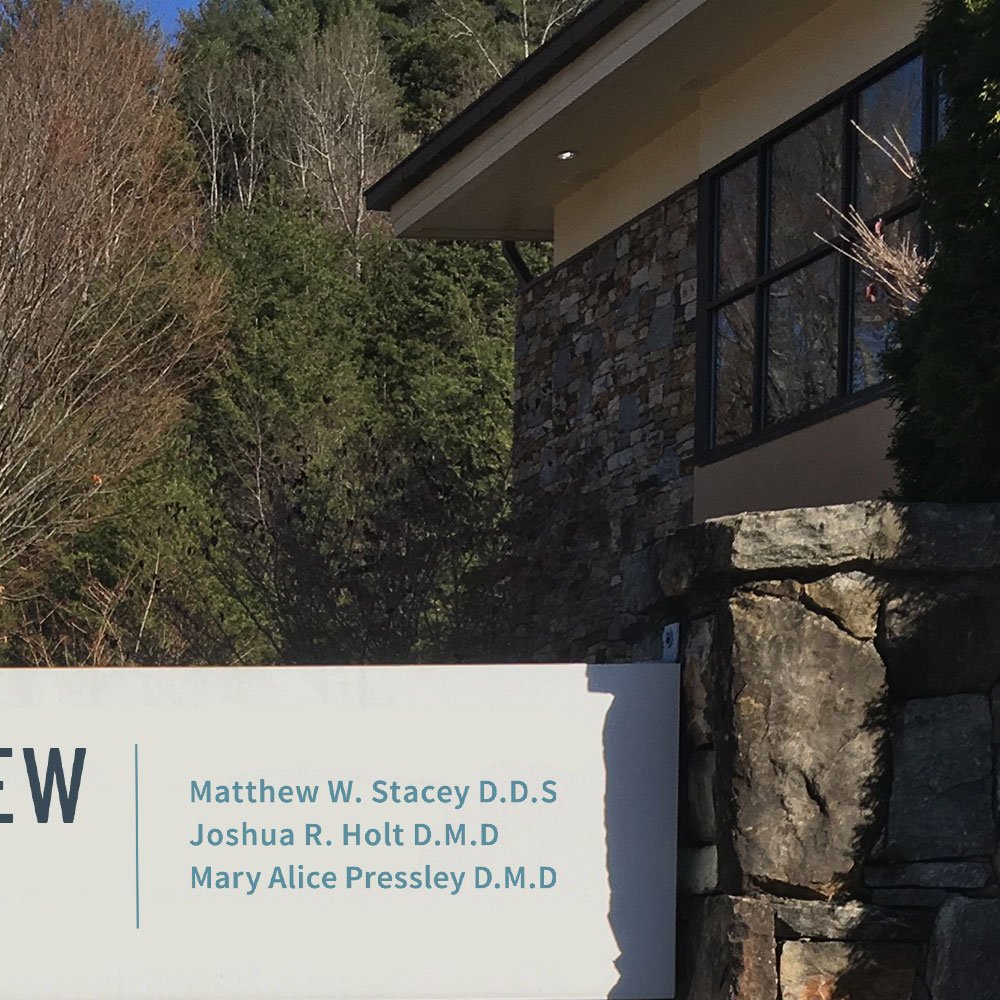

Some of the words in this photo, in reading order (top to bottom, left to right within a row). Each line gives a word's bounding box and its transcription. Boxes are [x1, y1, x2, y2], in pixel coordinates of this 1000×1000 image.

[190, 778, 320, 804] Matthew
[327, 779, 362, 804] W.
[371, 779, 471, 810] Stacey
[479, 779, 557, 804] D.D.S
[189, 821, 295, 847] Joshua
[305, 823, 332, 847] R.
[342, 821, 405, 847] Holt
[414, 823, 499, 847] D.M.D
[191, 865, 262, 896] Mary
[267, 864, 338, 890] Alice
[345, 864, 466, 896] Pressley
[474, 865, 557, 890] D.M.D
